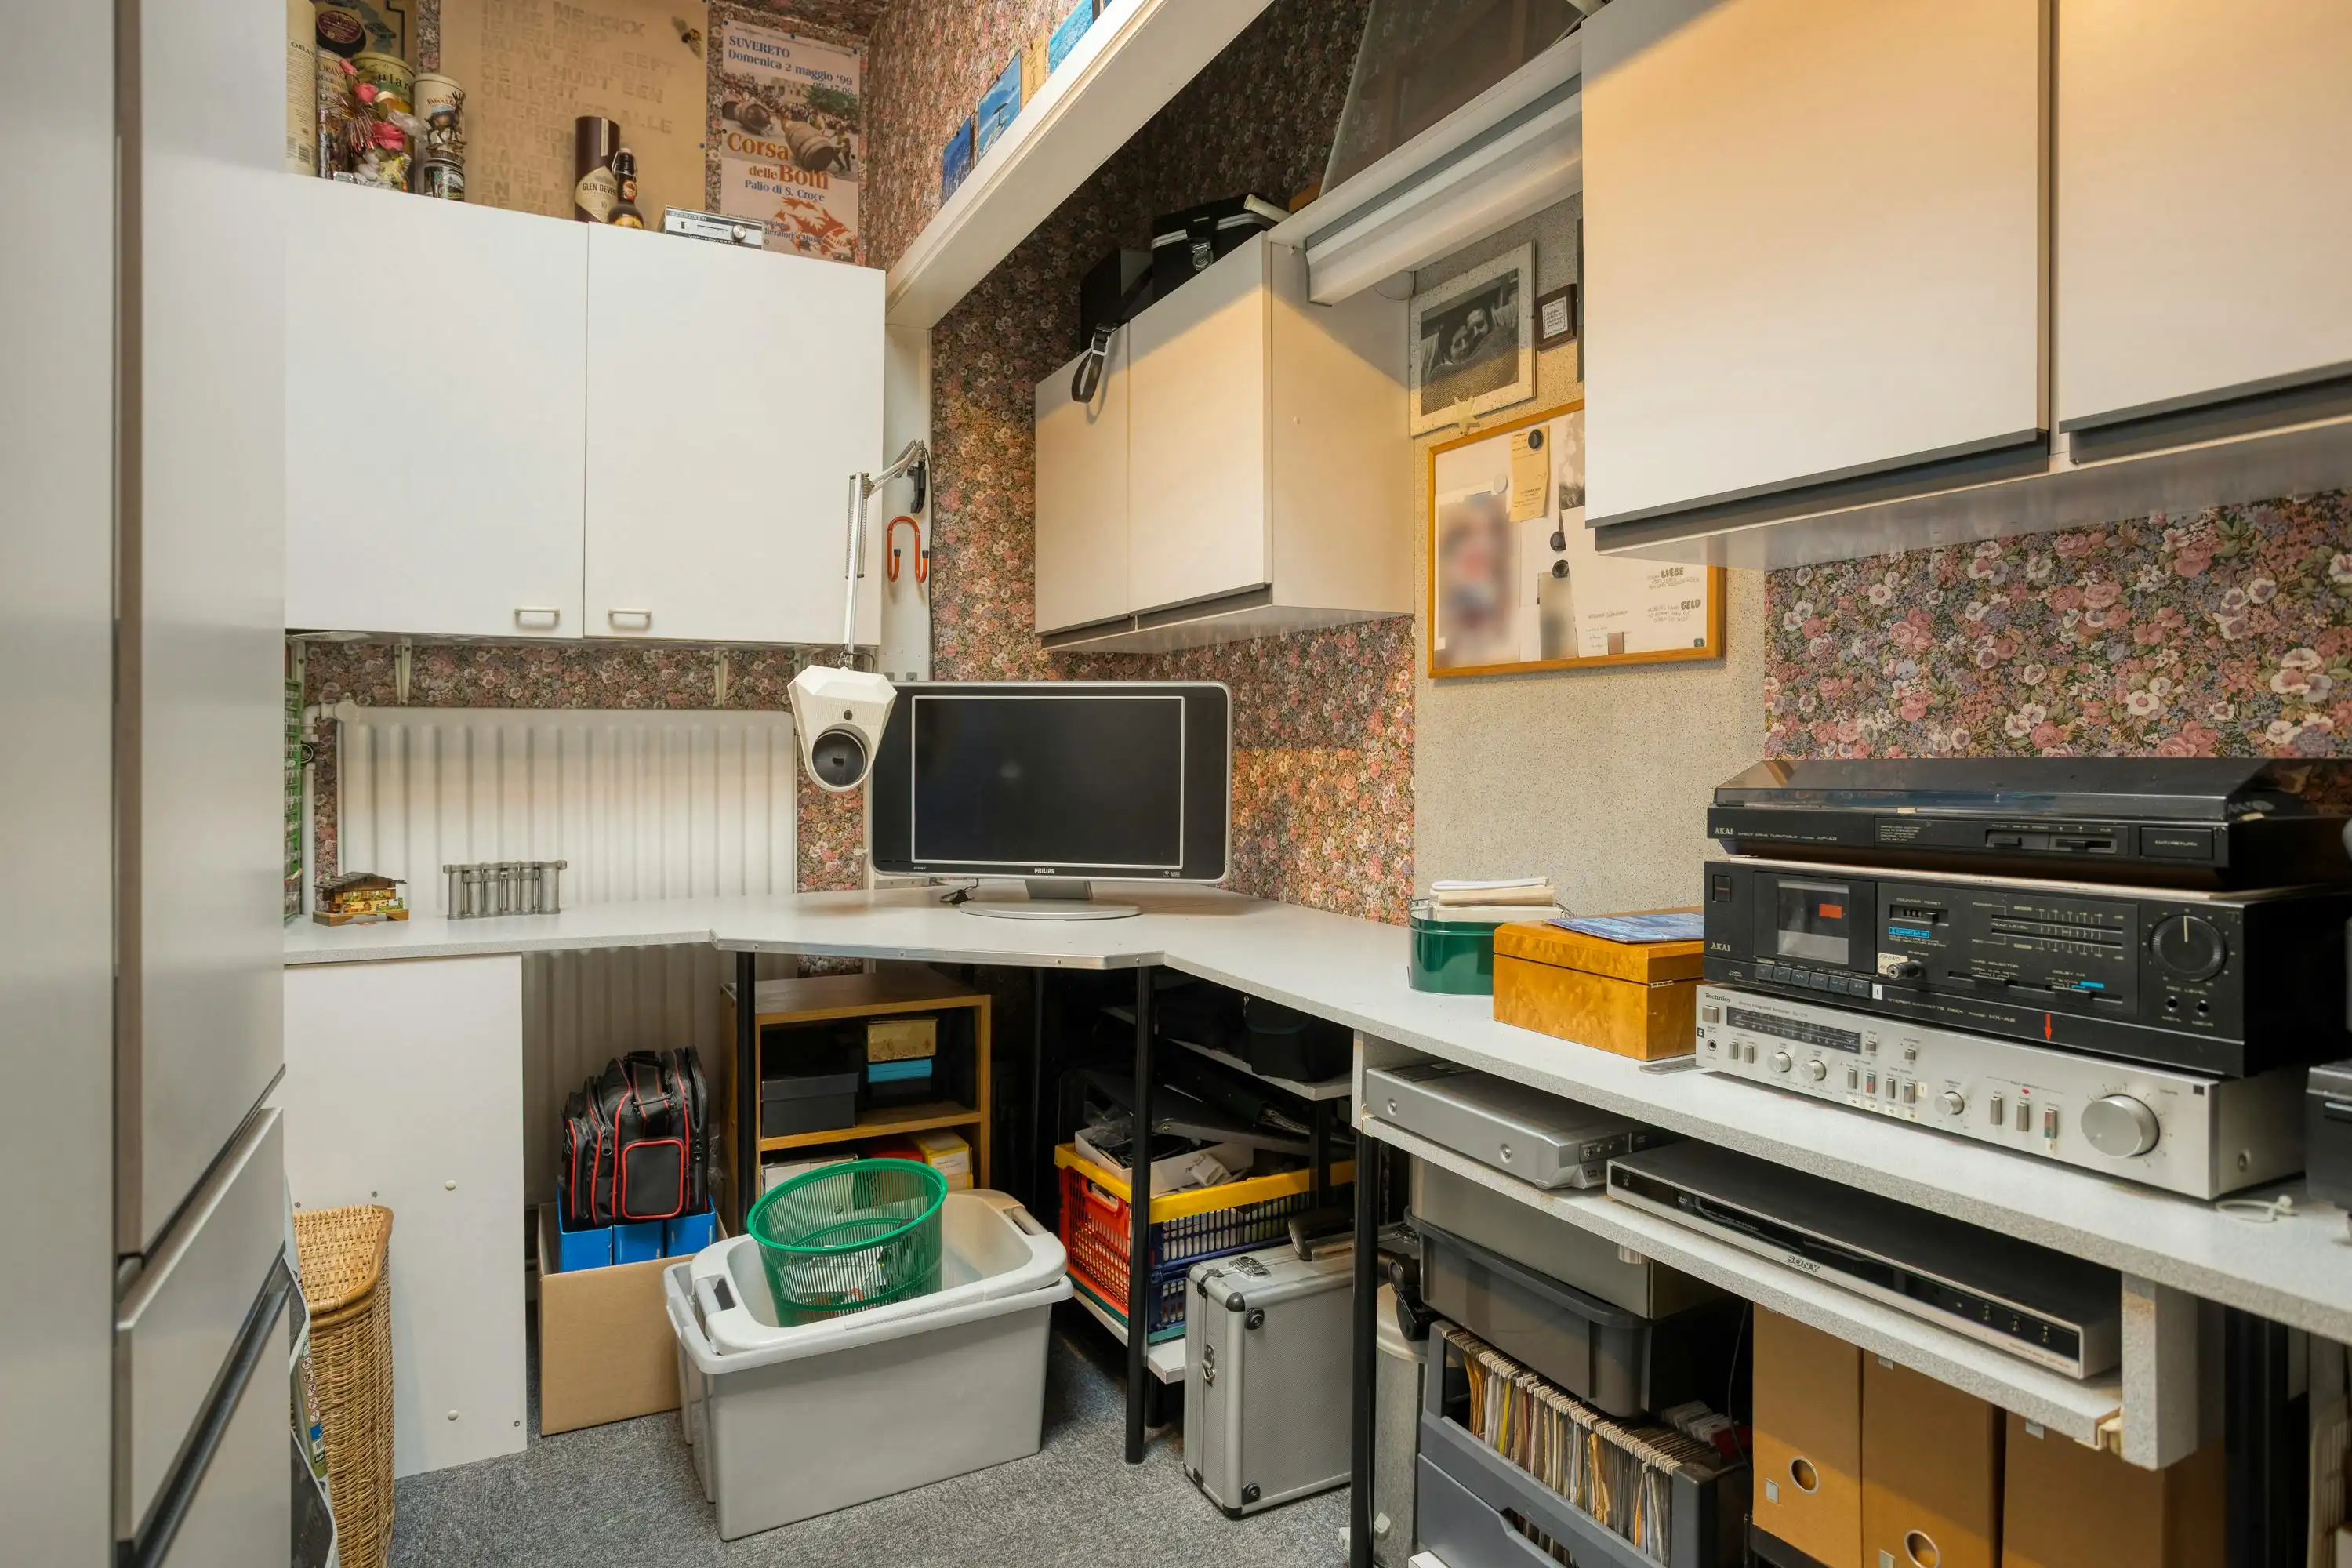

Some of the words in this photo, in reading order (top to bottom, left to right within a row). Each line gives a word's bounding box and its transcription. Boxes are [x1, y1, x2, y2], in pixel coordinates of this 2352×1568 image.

[729, 35, 791, 58] SUVERETO
[728, 49, 782, 70] Domenica
[785, 63, 792, 71] 2
[795, 65, 833, 82] maggio
[837, 74, 853, 85] '99
[727, 132, 789, 161] Corsa
[749, 165, 778, 180] delle
[779, 164, 829, 190] Botti
[745, 180, 769, 192] Palio
[772, 183, 782, 194] di
[785, 187, 793, 196] S.
[797, 189, 825, 202] Croce
[1681, 599, 1701, 611] GELD
[1711, 942, 1730, 952] AKAI
[1705, 993, 1731, 1004] Technics
[1787, 1254, 1821, 1273] SONY
